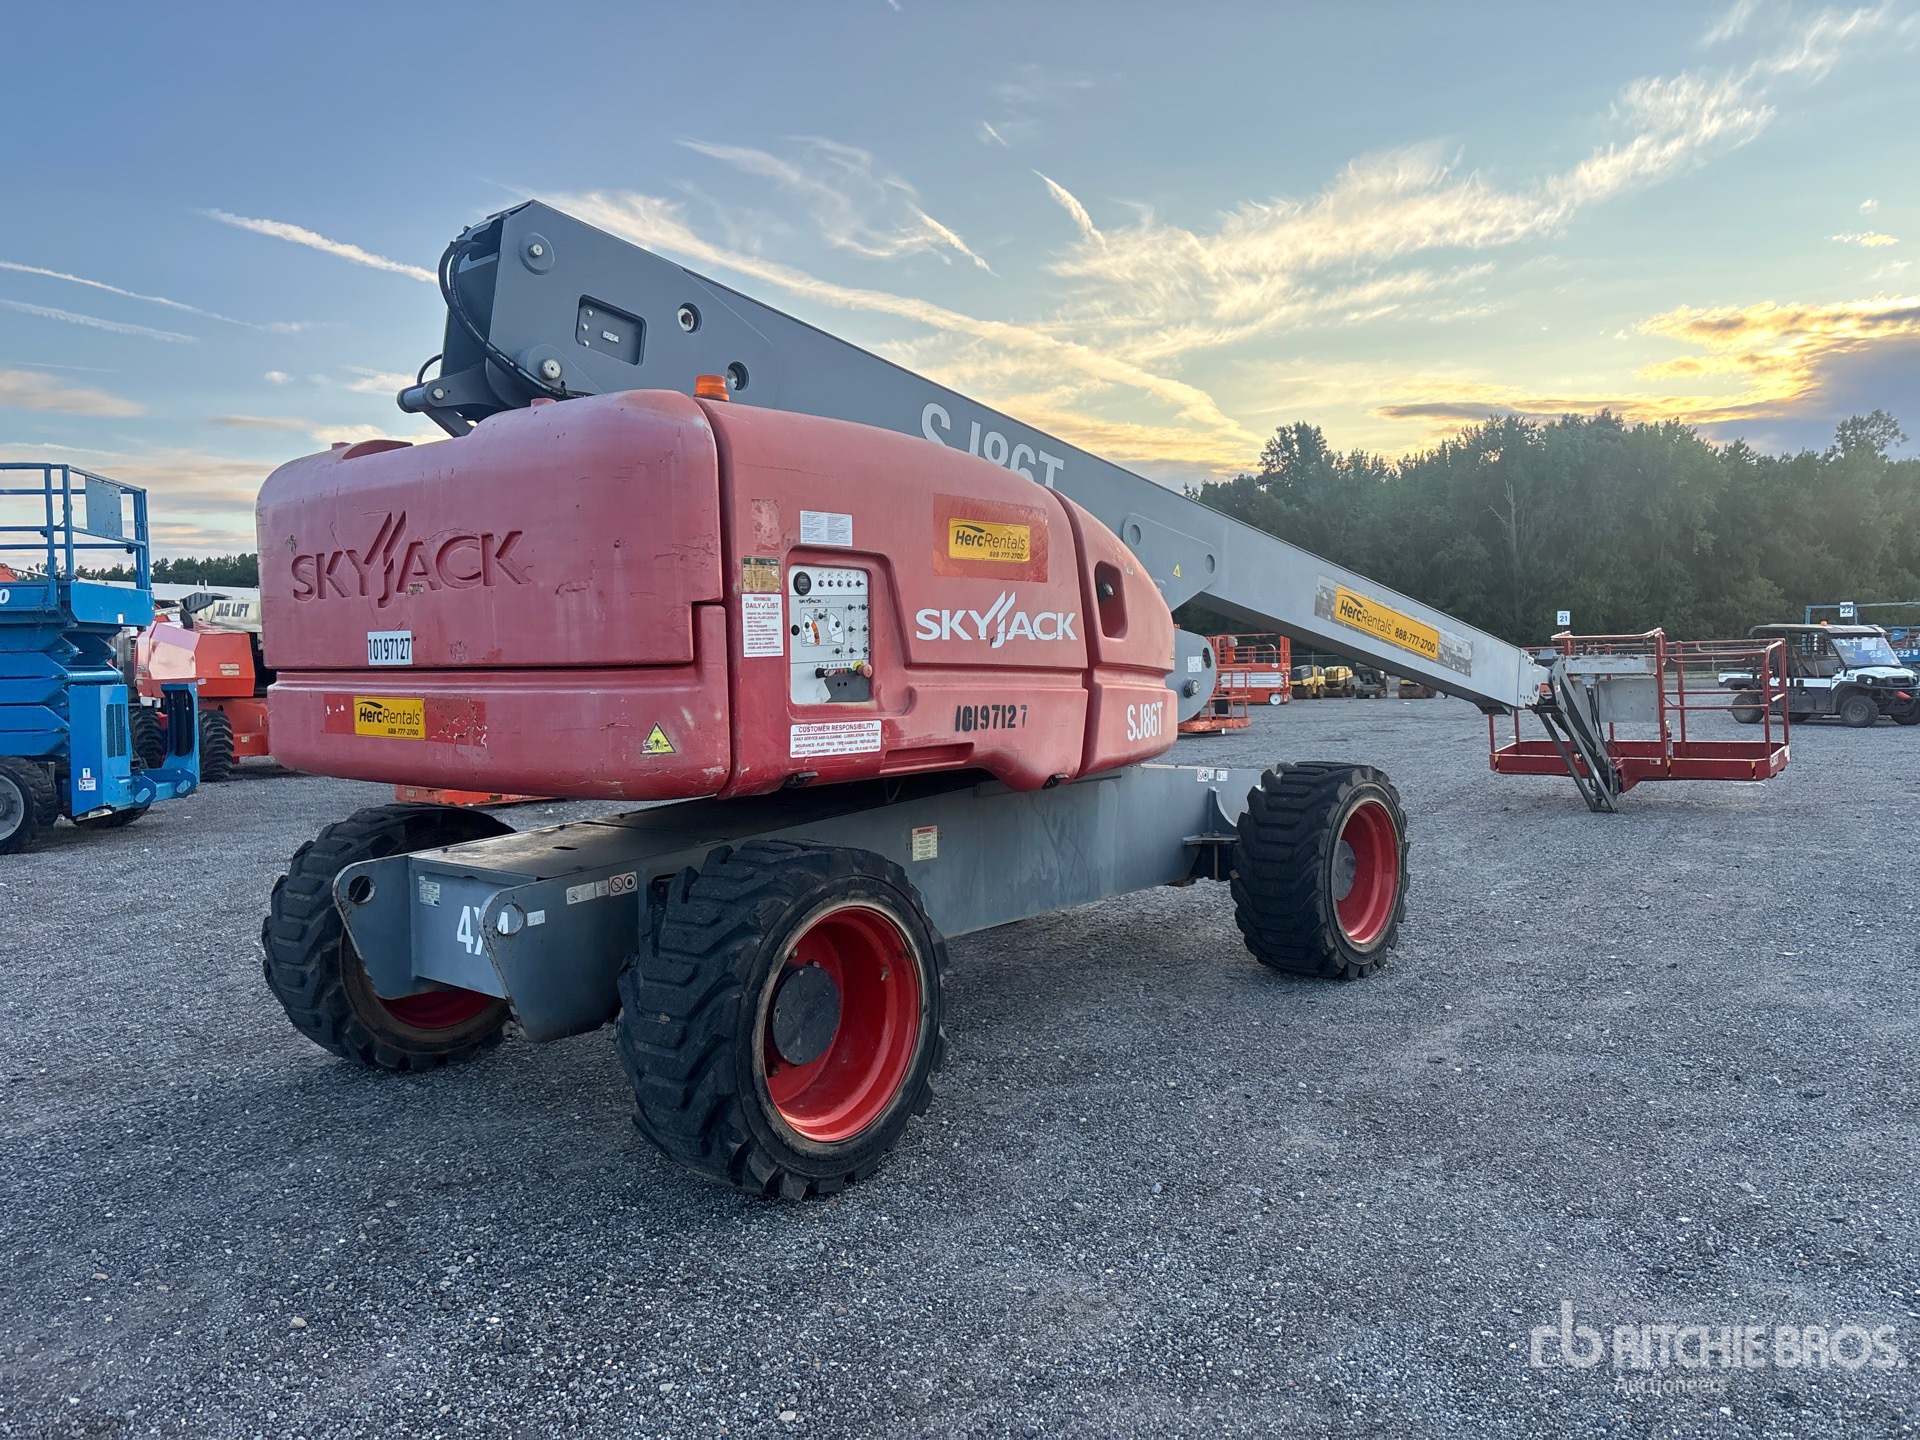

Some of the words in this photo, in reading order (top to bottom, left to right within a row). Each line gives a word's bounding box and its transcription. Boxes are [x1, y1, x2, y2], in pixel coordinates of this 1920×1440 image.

[955, 530, 1026, 550] HercRentals
[291, 511, 532, 608] SKYJACK
[216, 603, 231, 617] JLG
[232, 603, 250, 618] LIFT
[915, 591, 1077, 648] SKYJACK
[1340, 600, 1392, 634] HercRentals
[1394, 627, 1436, 653] 888-777-2700
[368, 637, 411, 661] 10197127
[359, 707, 420, 726] HercRentals
[798, 725, 830, 733] CUSTOMER
[831, 722, 875, 731] RESPONSIBILITY
[1127, 701, 1163, 742] SJ86T
[388, 728, 419, 736] 888-777-2700
